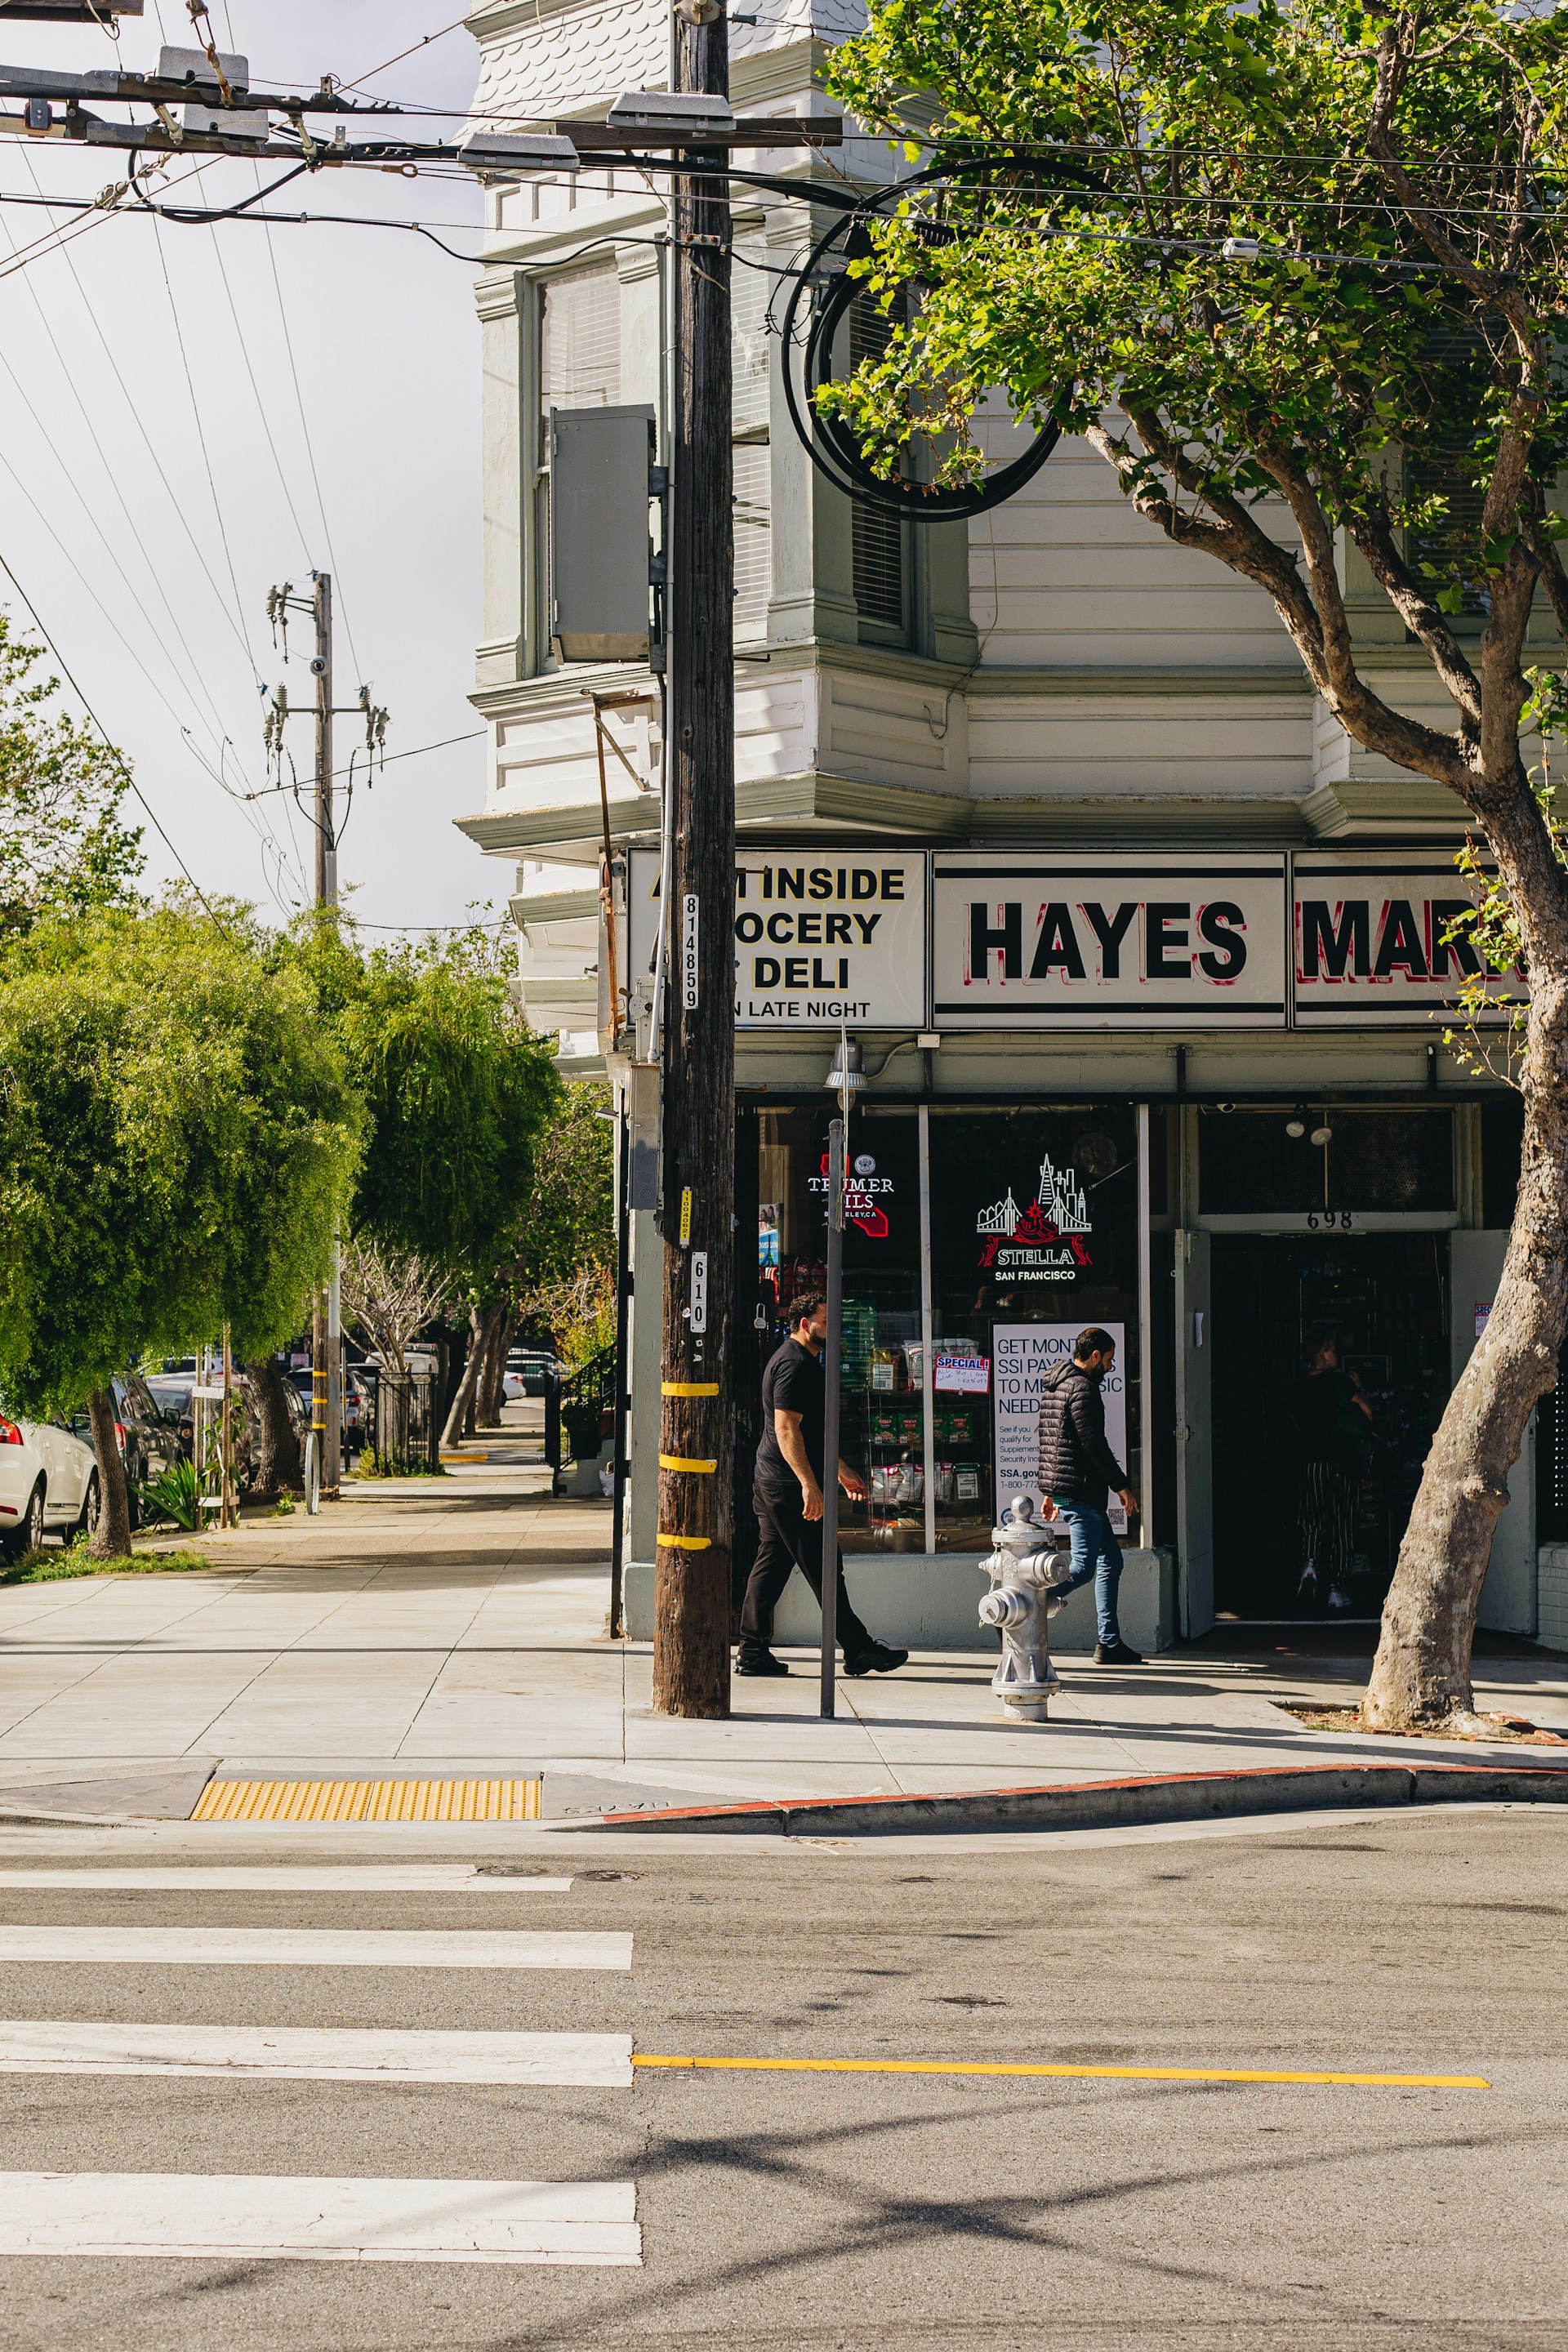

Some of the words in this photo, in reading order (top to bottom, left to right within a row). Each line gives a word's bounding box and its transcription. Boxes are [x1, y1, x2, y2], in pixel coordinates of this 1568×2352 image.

[763, 867, 905, 900] INSIDE
[735, 912, 882, 944] OCERY
[964, 901, 1248, 985] HAYES
[686, 898, 697, 1007] 814859
[755, 957, 849, 989] DELI
[749, 1001, 800, 1017] LATE
[807, 1001, 871, 1018] NIGHT
[845, 1194, 874, 1209] ILS
[1307, 1211, 1352, 1229] 698
[997, 1249, 1075, 1265] STELLA
[996, 1272, 1015, 1281] SAN
[1018, 1271, 1076, 1281] FRANCISCO
[695, 1261, 704, 1323] 610
[1476, 1306, 1492, 1314] SPEC
[998, 1339, 1030, 1354] GET
[938, 1356, 982, 1369] SPECIAL
[998, 1359, 1023, 1374] SSI
[998, 1379, 1020, 1393] TO
[1099, 1378, 1122, 1392] SIC
[999, 1398, 1040, 1414] NEED
[999, 1425, 1012, 1433] See
[1013, 1425, 1018, 1433] if
[1018, 1427, 1031, 1435] you
[999, 1435, 1022, 1444] qualify
[1022, 1435, 1032, 1443] for
[1000, 1445, 1040, 1454] Supplement
[1000, 1455, 1027, 1464] Security
[1000, 1468, 1040, 1479] SSA.gov
[1000, 1480, 1040, 1489] 1-800-772
